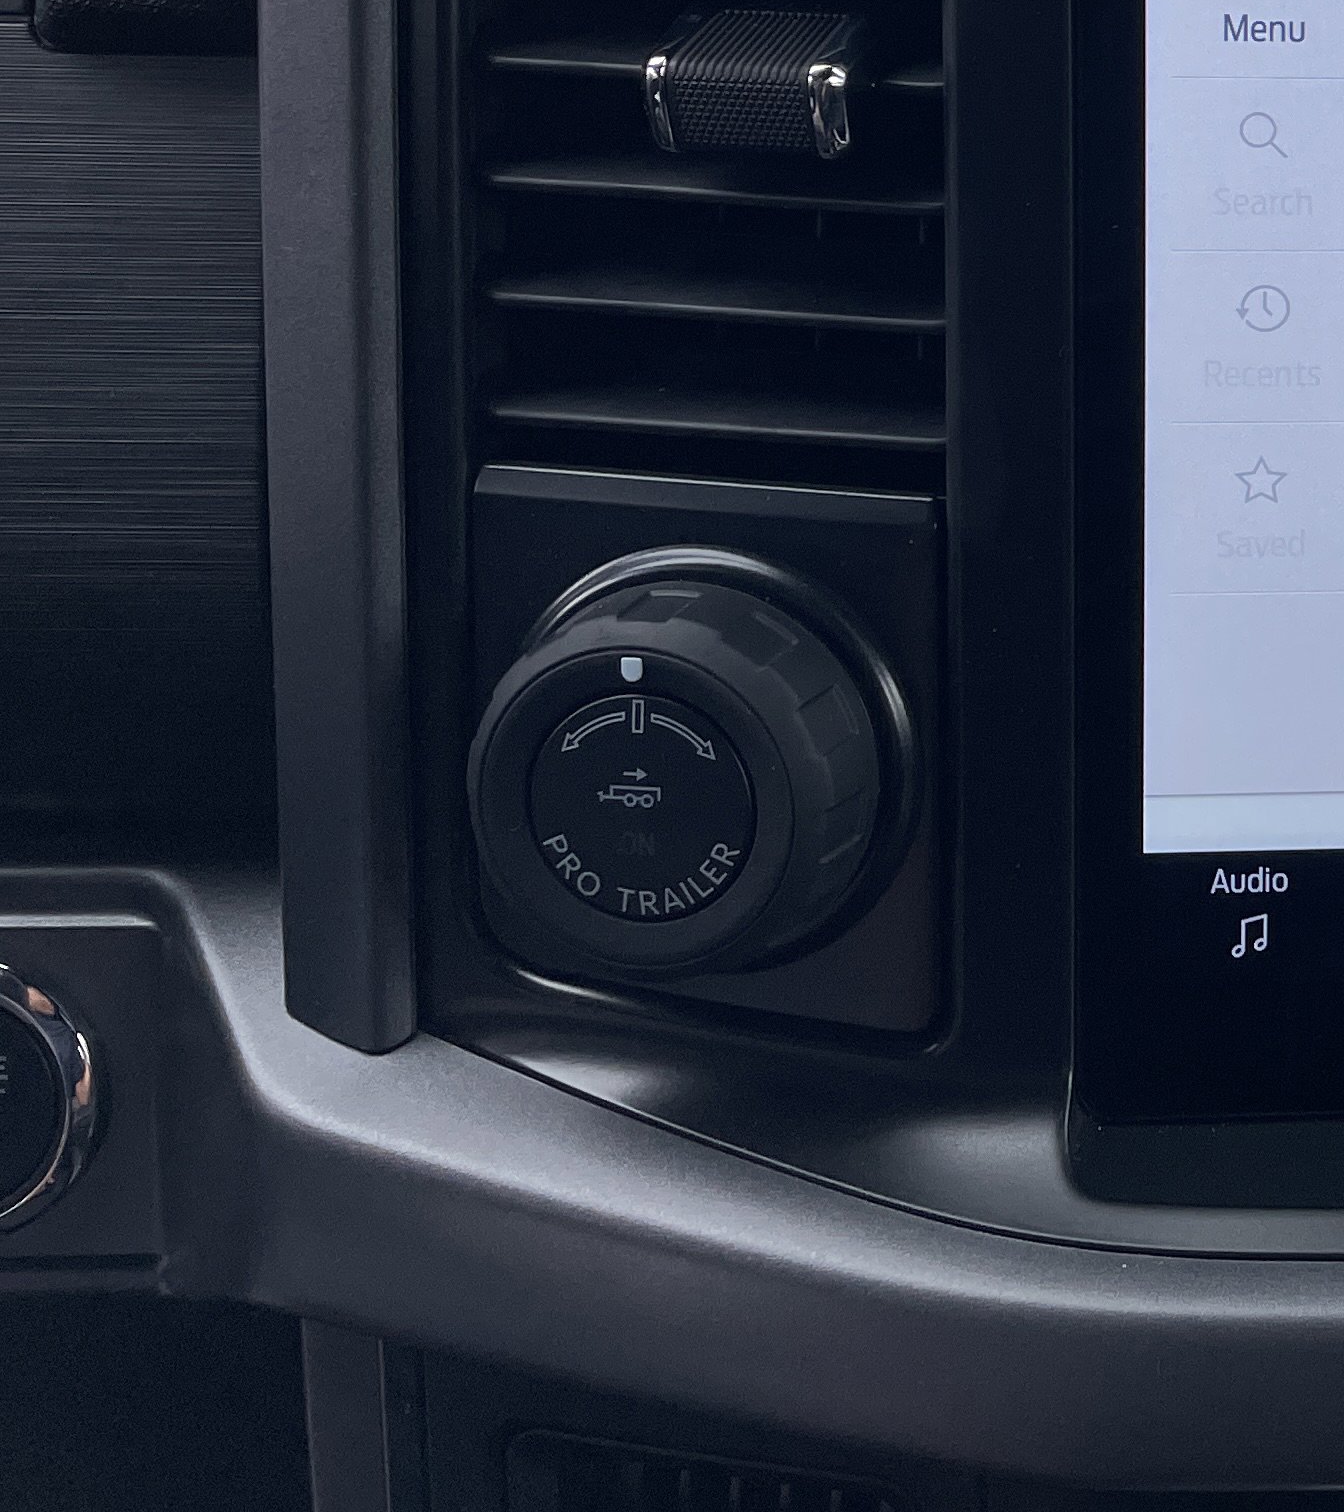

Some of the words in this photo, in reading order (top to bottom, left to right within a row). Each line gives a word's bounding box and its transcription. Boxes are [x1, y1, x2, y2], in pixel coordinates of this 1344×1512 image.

[1223, 15, 1307, 43] Menu
[1213, 189, 1313, 216] Search
[1205, 361, 1321, 387] Recents
[1217, 531, 1305, 558] Saved
[542, 834, 601, 896] PRO
[617, 842, 741, 916] TRAILER
[1210, 868, 1289, 895] Audio
